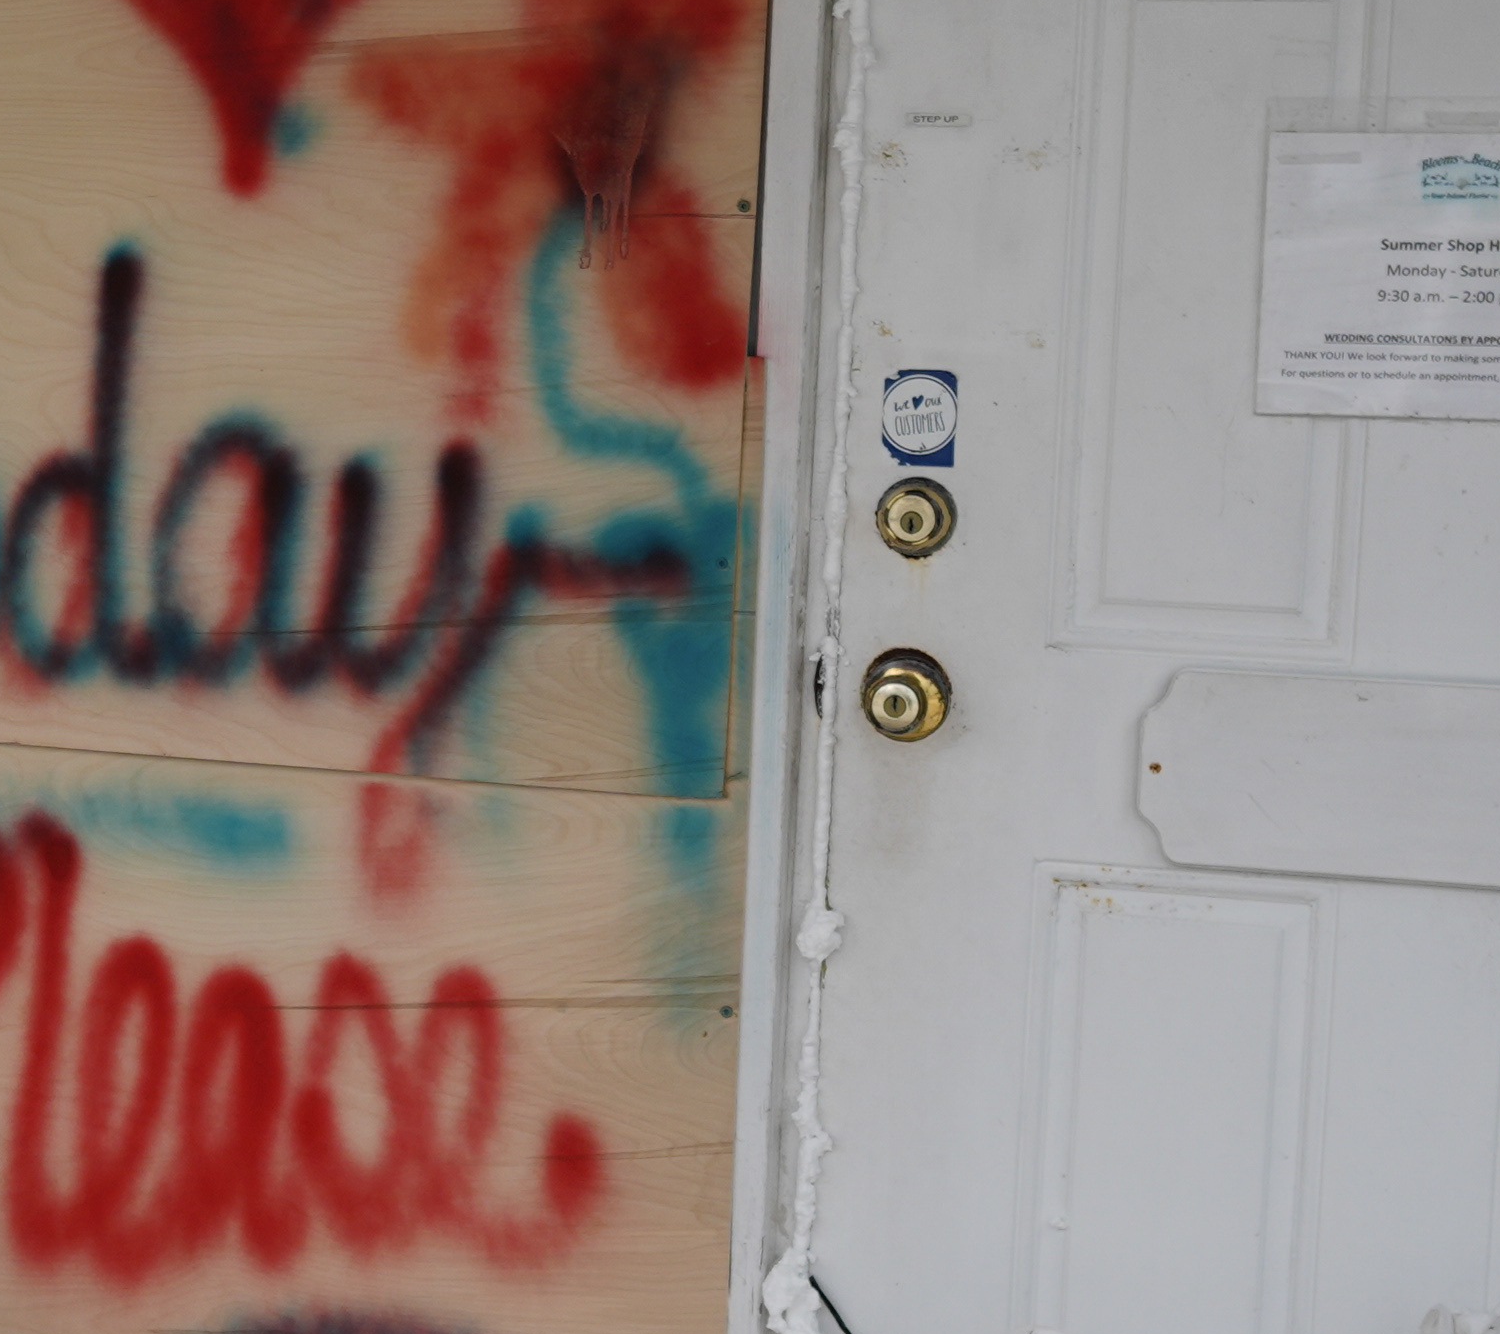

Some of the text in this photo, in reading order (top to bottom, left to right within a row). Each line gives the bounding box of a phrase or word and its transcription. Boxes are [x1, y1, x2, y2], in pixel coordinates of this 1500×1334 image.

[913, 115, 959, 123] STEP UP
[1422, 155, 1459, 171] Blooms
[1381, 238, 1443, 251] Summer
[1448, 239, 1485, 254] Shop
[1387, 264, 1447, 279] Monday
[1377, 290, 1410, 302] 9:30
[1413, 292, 1445, 303] a.m.
[1463, 291, 1495, 304] 2:00
[1325, 333, 1374, 343] WEDDING
[1377, 334, 1458, 345] CONSULTATONS
[1284, 351, 1318, 360] THANK
[1320, 352, 1345, 360] YOU!
[1347, 352, 1364, 360] We
[1366, 352, 1387, 361] look
[1390, 353, 1428, 362] forward
[1431, 354, 1441, 362] to
[1444, 353, 1479, 364] making
[1281, 369, 1296, 377] For
[1299, 369, 1345, 379] questions
[1361, 371, 1371, 379] to
[1374, 371, 1417, 380] schedule
[1434, 373, 1500, 382] appointment,
[895, 411, 946, 436] CUSTOMERS
